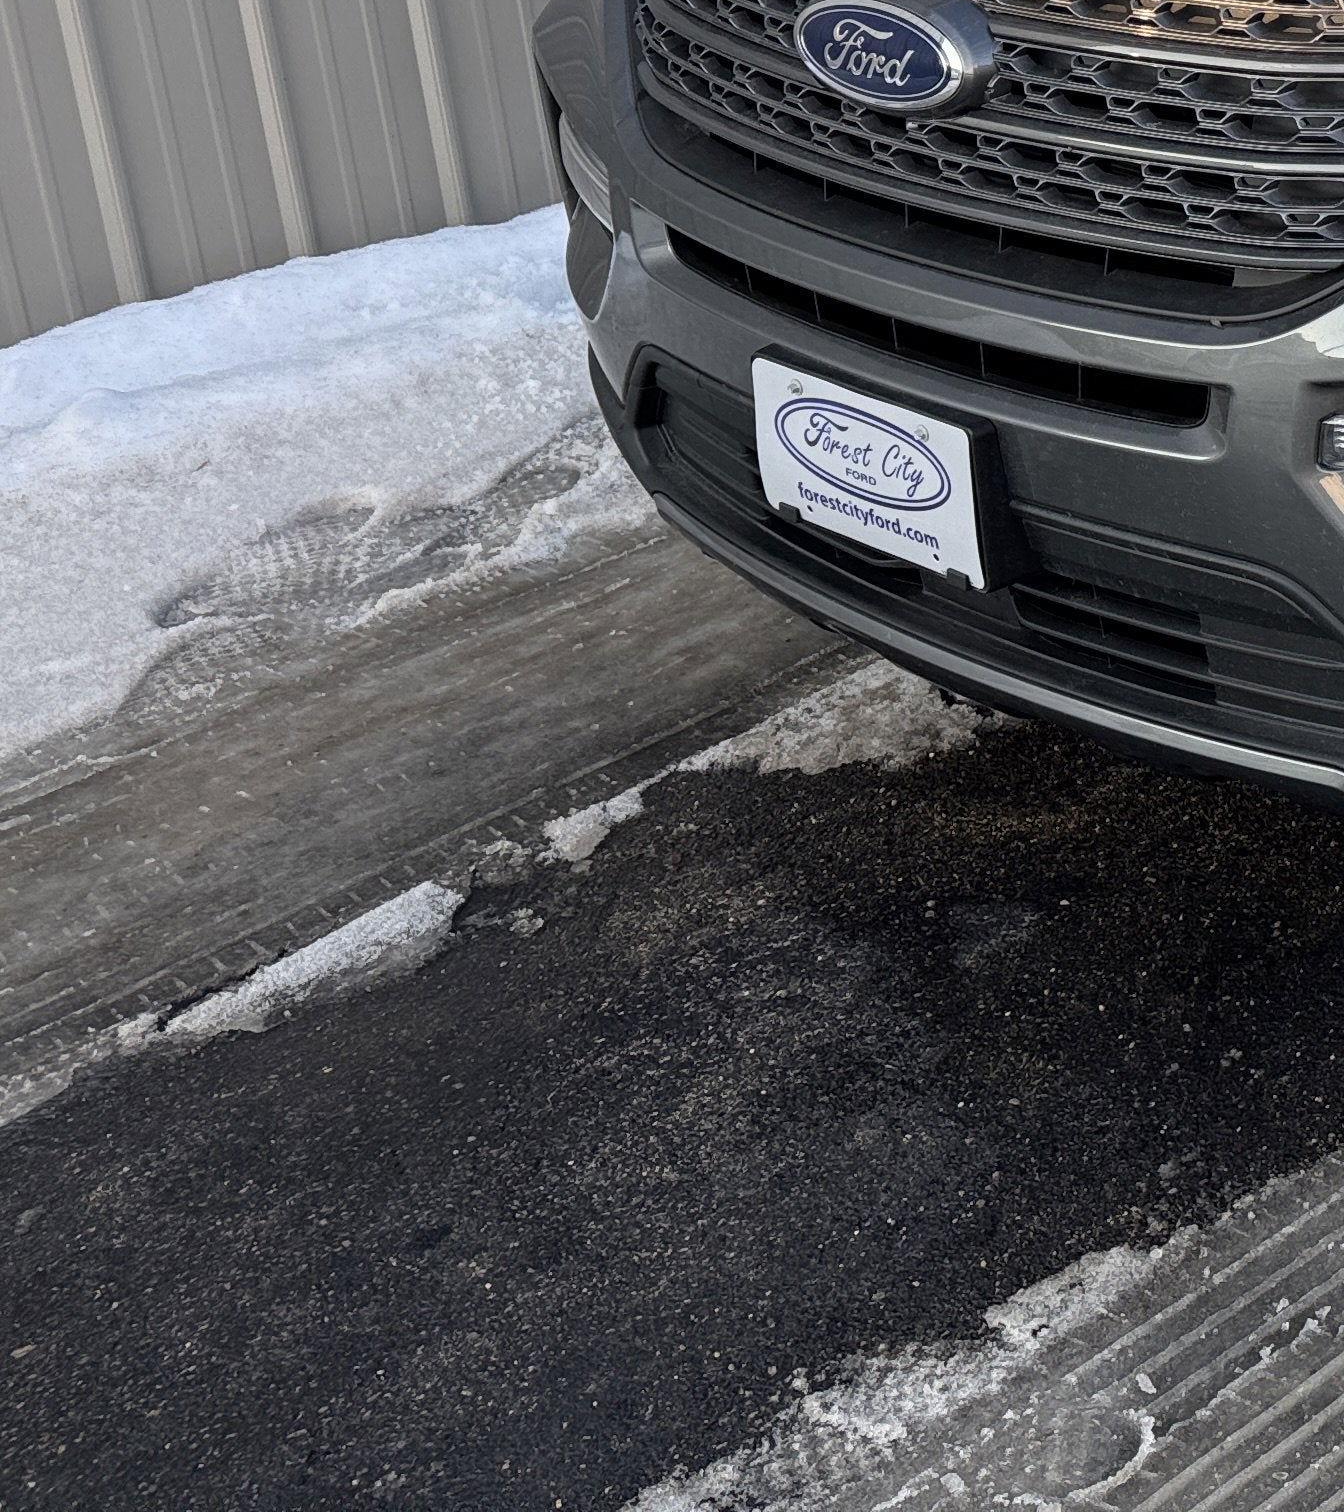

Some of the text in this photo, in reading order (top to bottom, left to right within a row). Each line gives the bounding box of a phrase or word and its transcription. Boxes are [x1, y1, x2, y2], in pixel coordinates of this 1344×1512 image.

[824, 19, 914, 86] Ford
[804, 413, 924, 497] Forest City
[845, 467, 877, 486] FORD
[797, 481, 940, 550] forestcityford.com
